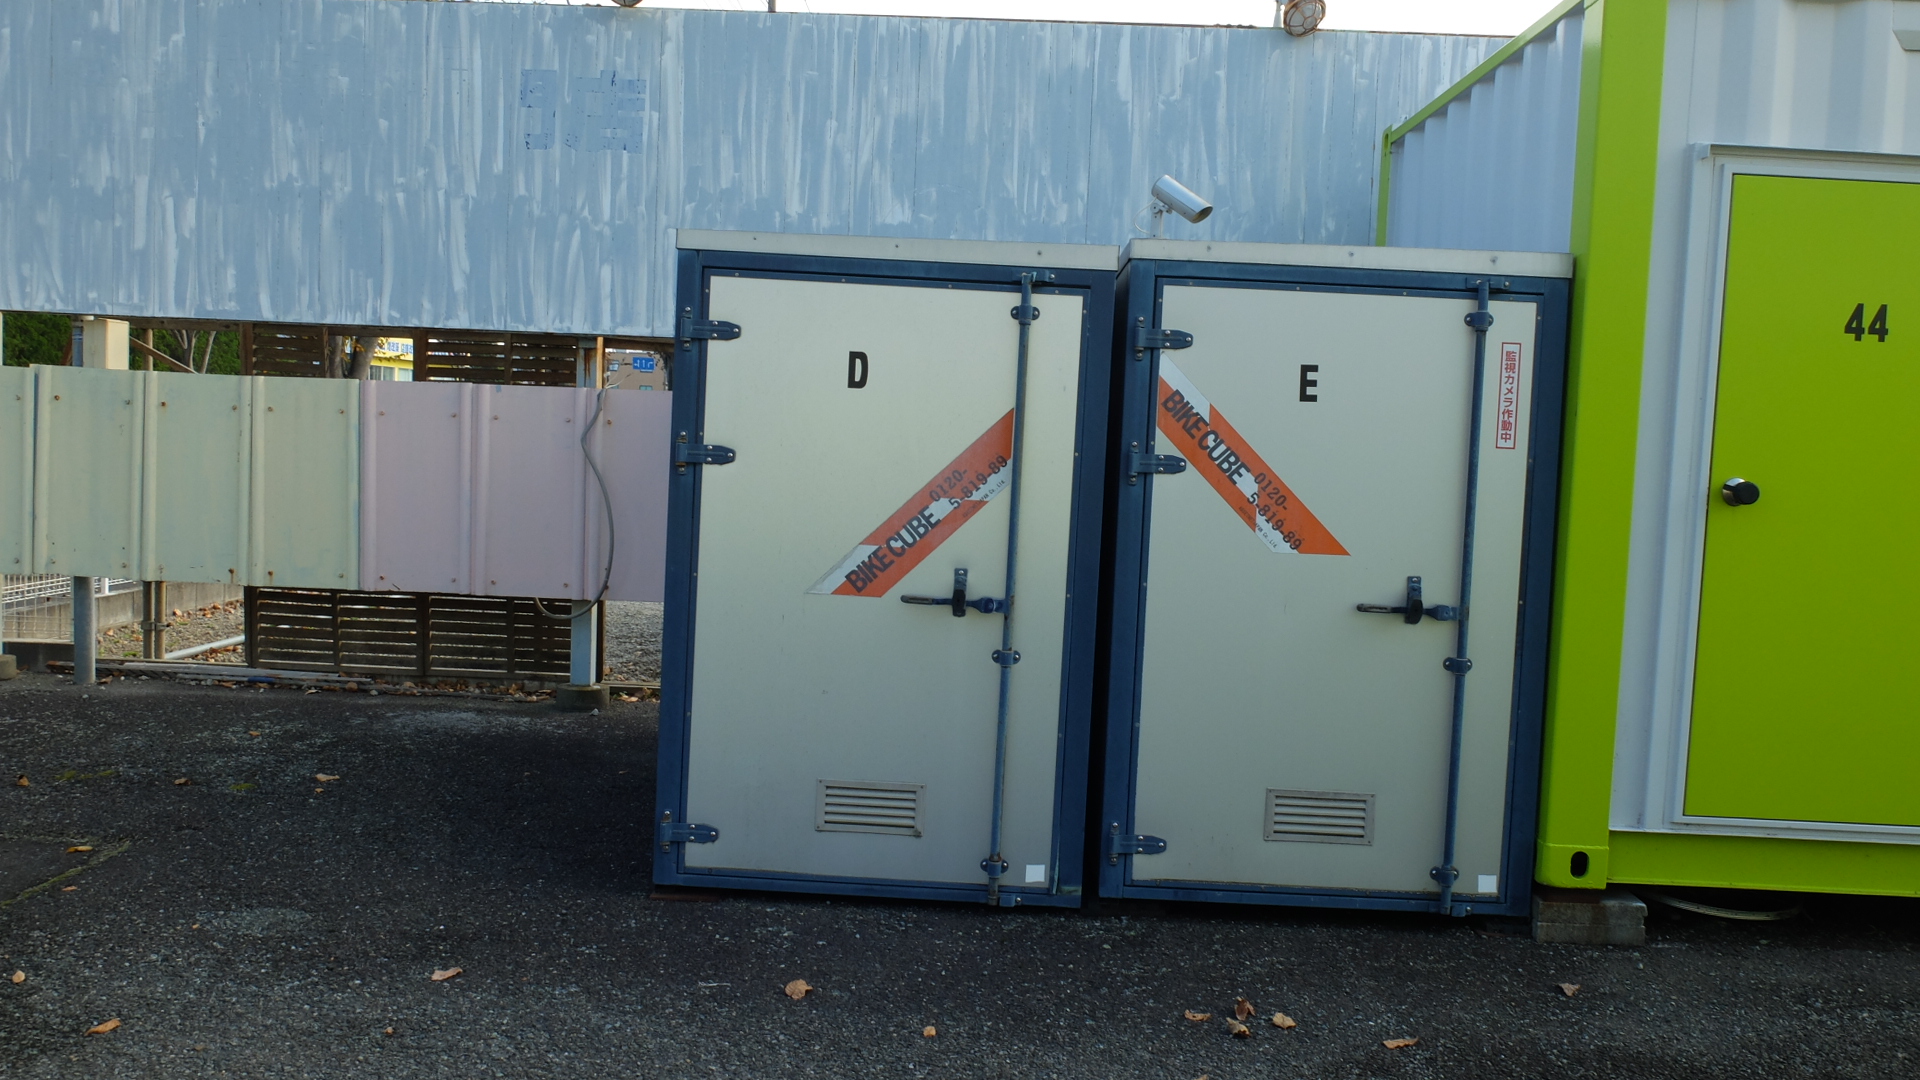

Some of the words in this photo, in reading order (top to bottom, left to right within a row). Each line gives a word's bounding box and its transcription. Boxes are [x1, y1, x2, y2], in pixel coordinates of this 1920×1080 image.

[1844, 303, 1889, 342] 44
[847, 351, 869, 389] D
[1299, 364, 1319, 403] E
[1500, 350, 1517, 443] 監視カメラ作動中
[1160, 389, 1209, 440] BIKE
[1197, 429, 1251, 485] CUBE
[929, 469, 968, 502] 0120-
[948, 454, 1008, 509] 5-819-89
[1253, 472, 1288, 511] 0120-
[1247, 492, 1304, 550] 5-819-89
[844, 546, 895, 594] BIKE
[885, 505, 941, 558] CUBE
